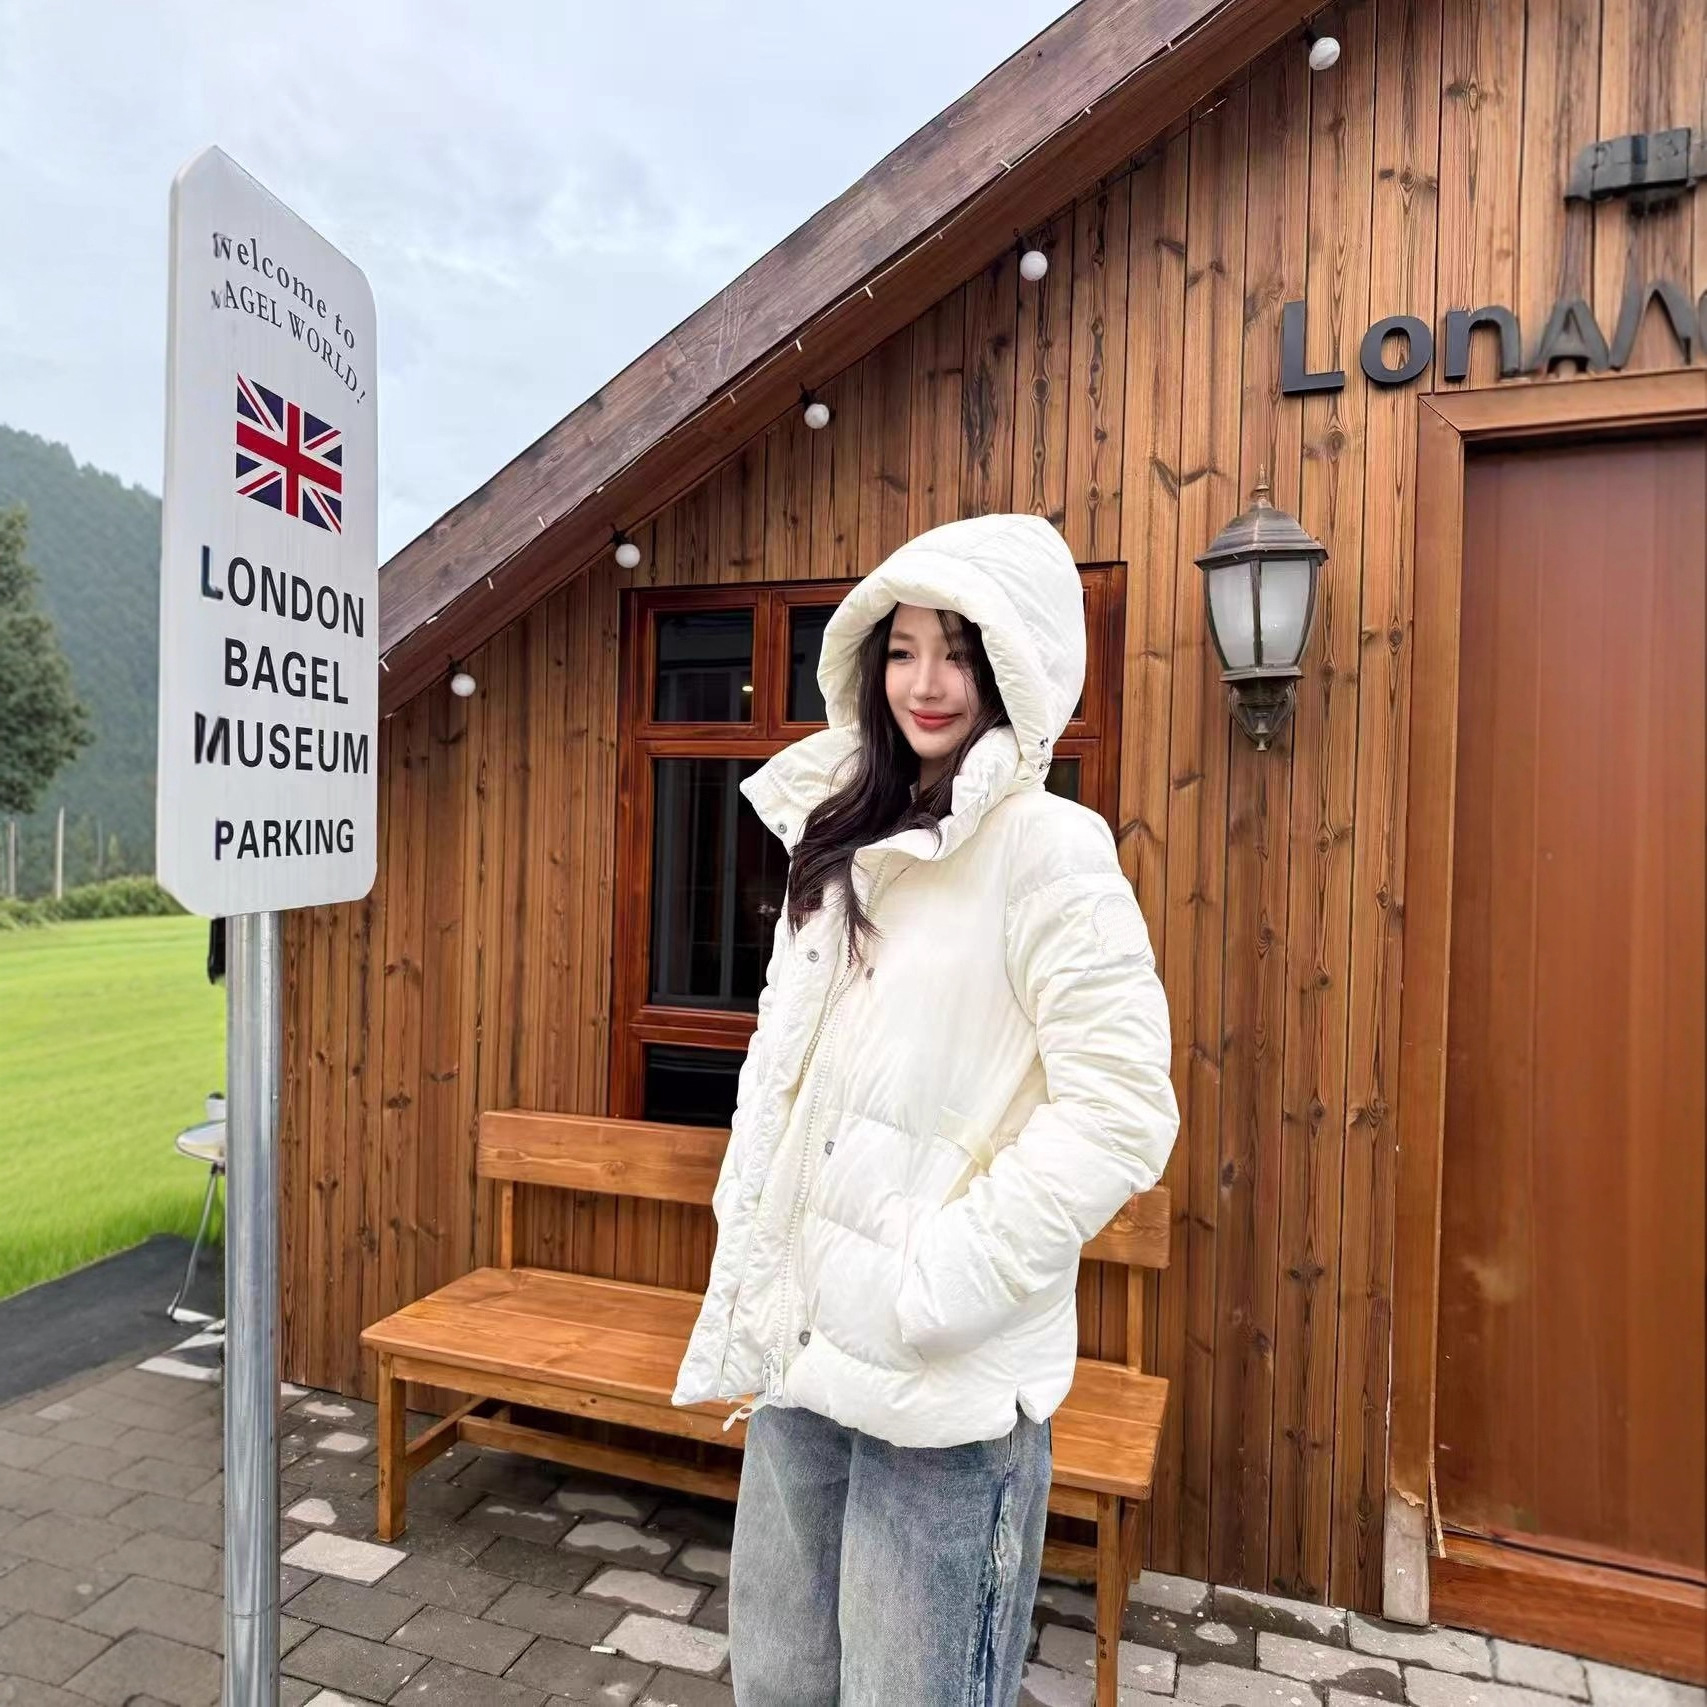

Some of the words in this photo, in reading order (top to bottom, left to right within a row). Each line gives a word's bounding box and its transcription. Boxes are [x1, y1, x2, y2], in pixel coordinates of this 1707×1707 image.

[287, 309, 366, 404] WORLD!
[335, 313, 355, 349] to
[201, 545, 364, 638] LONDON
[225, 637, 349, 704] BAGEL
[194, 711, 369, 774] MUSEUM
[214, 818, 355, 861] PARKING
